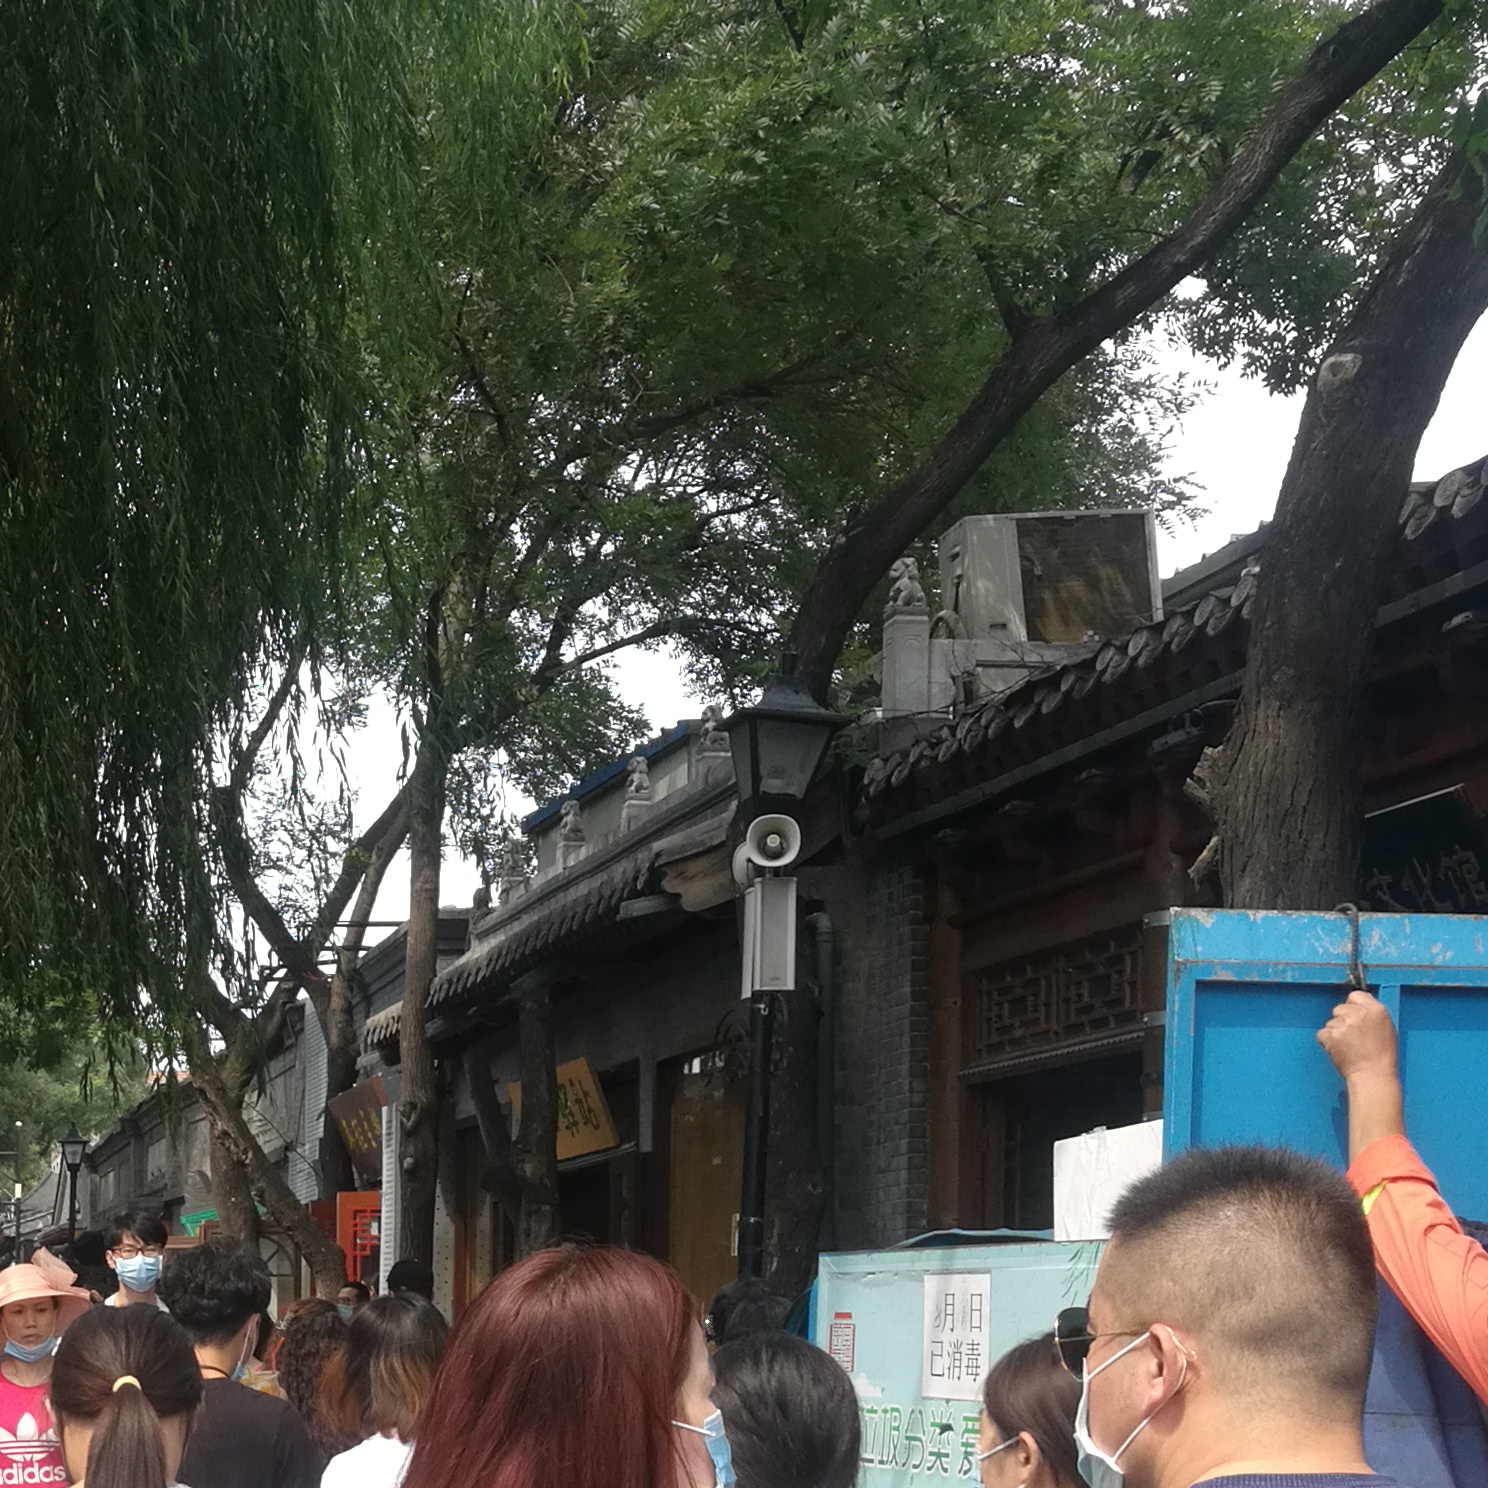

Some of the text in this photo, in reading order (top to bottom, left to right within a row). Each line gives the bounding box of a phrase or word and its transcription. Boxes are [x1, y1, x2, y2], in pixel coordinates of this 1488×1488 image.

[930, 1338, 982, 1383] 已消毒
[858, 1404, 951, 1475] 垃圾分类
